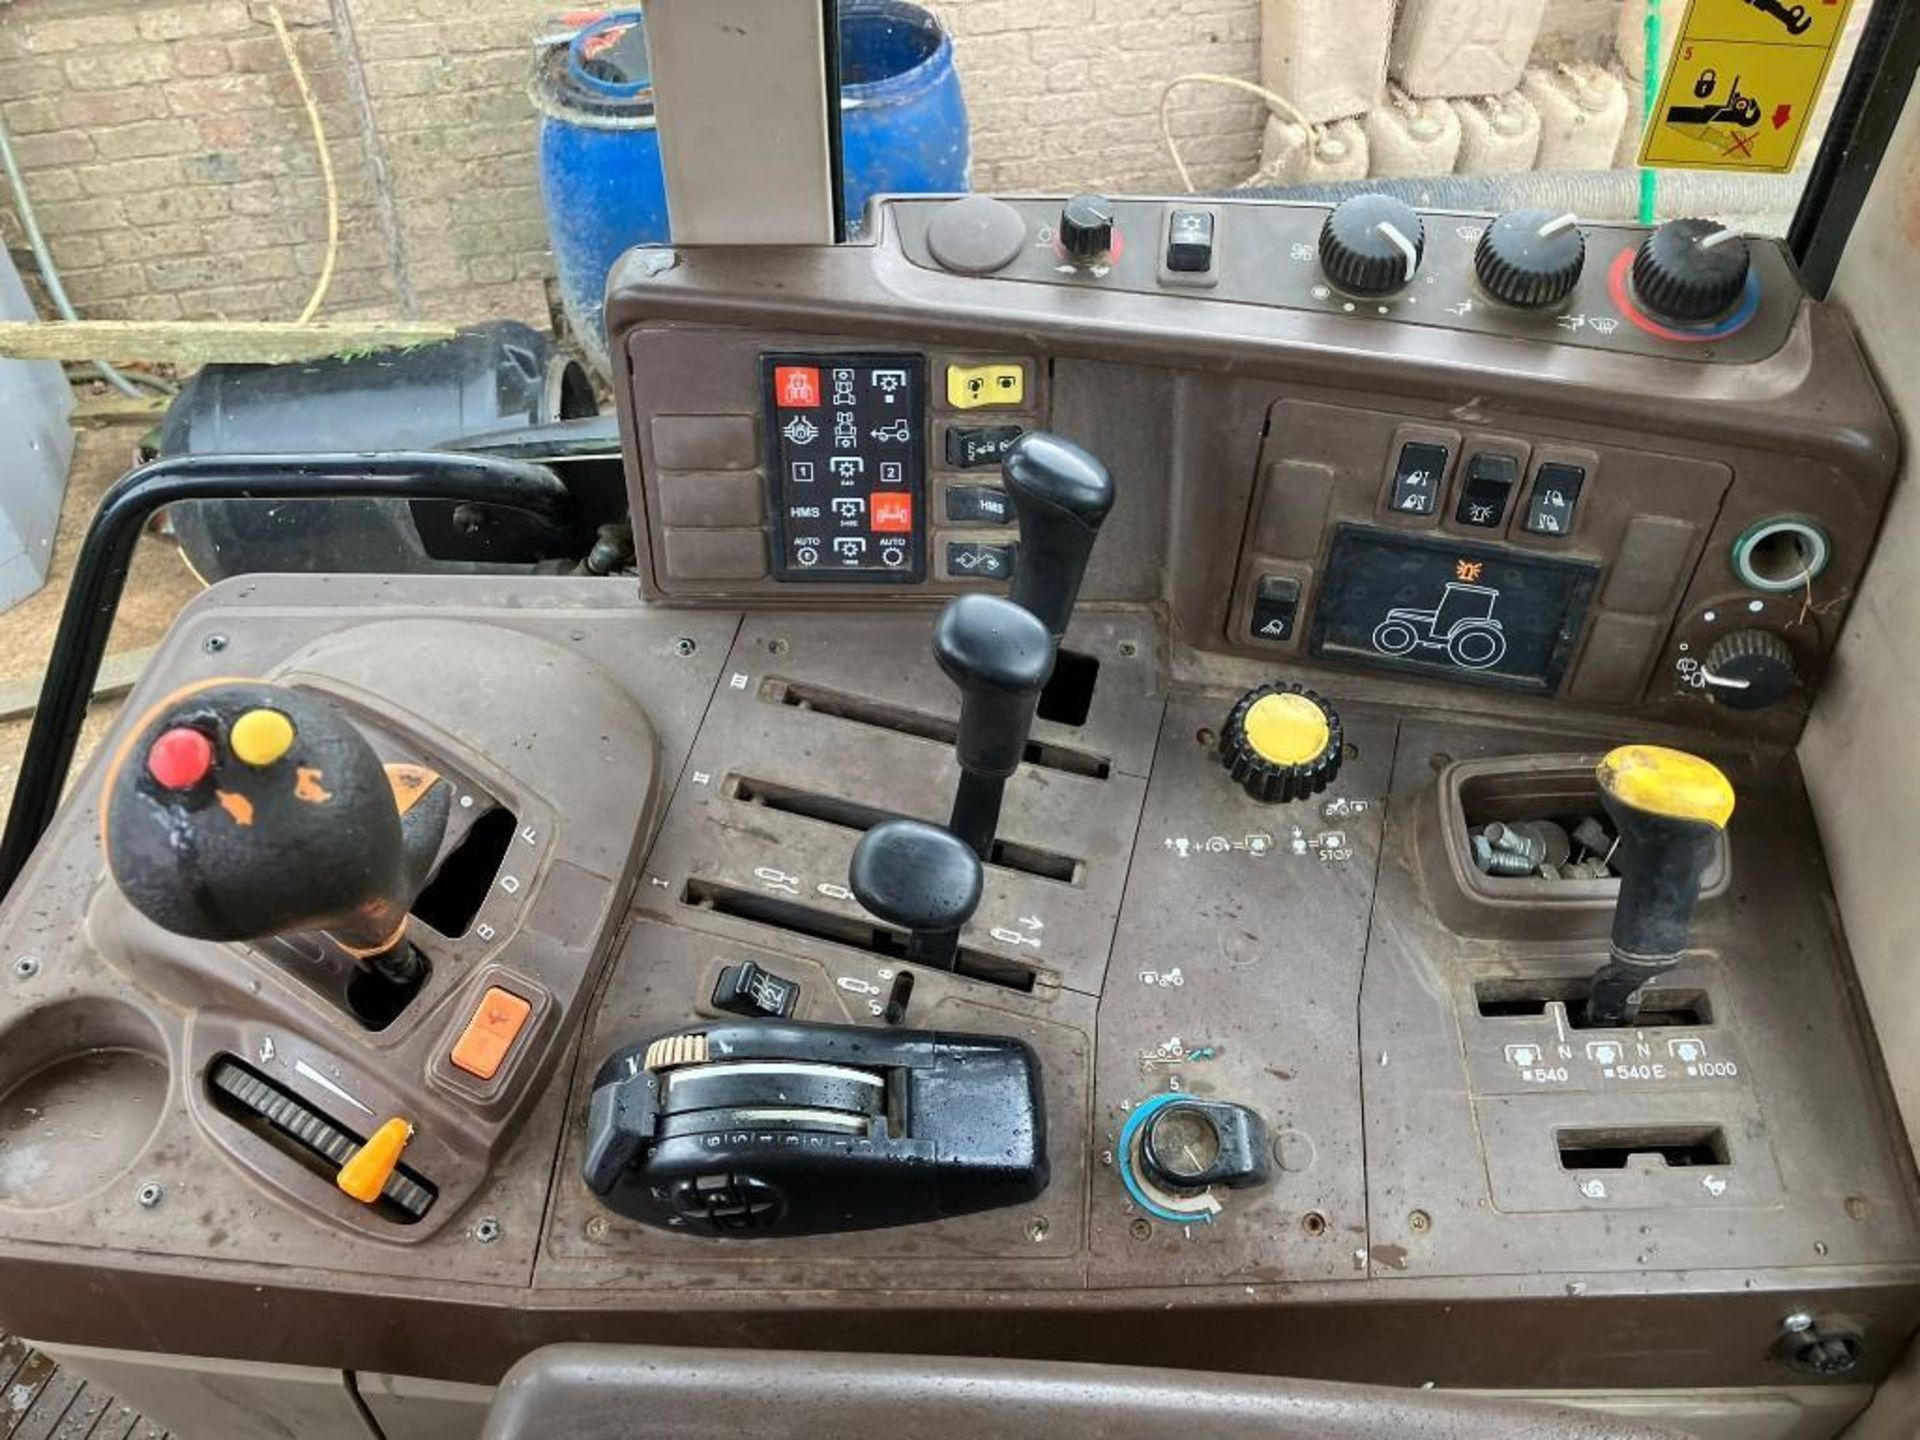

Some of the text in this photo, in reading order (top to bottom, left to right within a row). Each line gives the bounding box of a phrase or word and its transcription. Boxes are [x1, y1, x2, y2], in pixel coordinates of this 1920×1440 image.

[799, 465, 807, 477] 1
[886, 467, 896, 478] 2
[790, 506, 820, 518] HMS
[979, 499, 1005, 515] HMS
[794, 537, 821, 546] AUTO
[880, 538, 906, 546] AUTO
[521, 825, 537, 845] F
[1319, 848, 1353, 861] STOP
[501, 875, 520, 893] D
[476, 923, 495, 940] B
[1559, 1045, 1572, 1059] N
[1636, 1043, 1651, 1058] N
[1534, 1066, 1569, 1081] 540
[1698, 1062, 1737, 1077] 1000
[1169, 1075, 1179, 1090] 5
[707, 1136, 720, 1147] 6
[786, 1136, 799, 1145] 3
[1101, 1151, 1112, 1164] 3
[1184, 1226, 1191, 1239] 1
